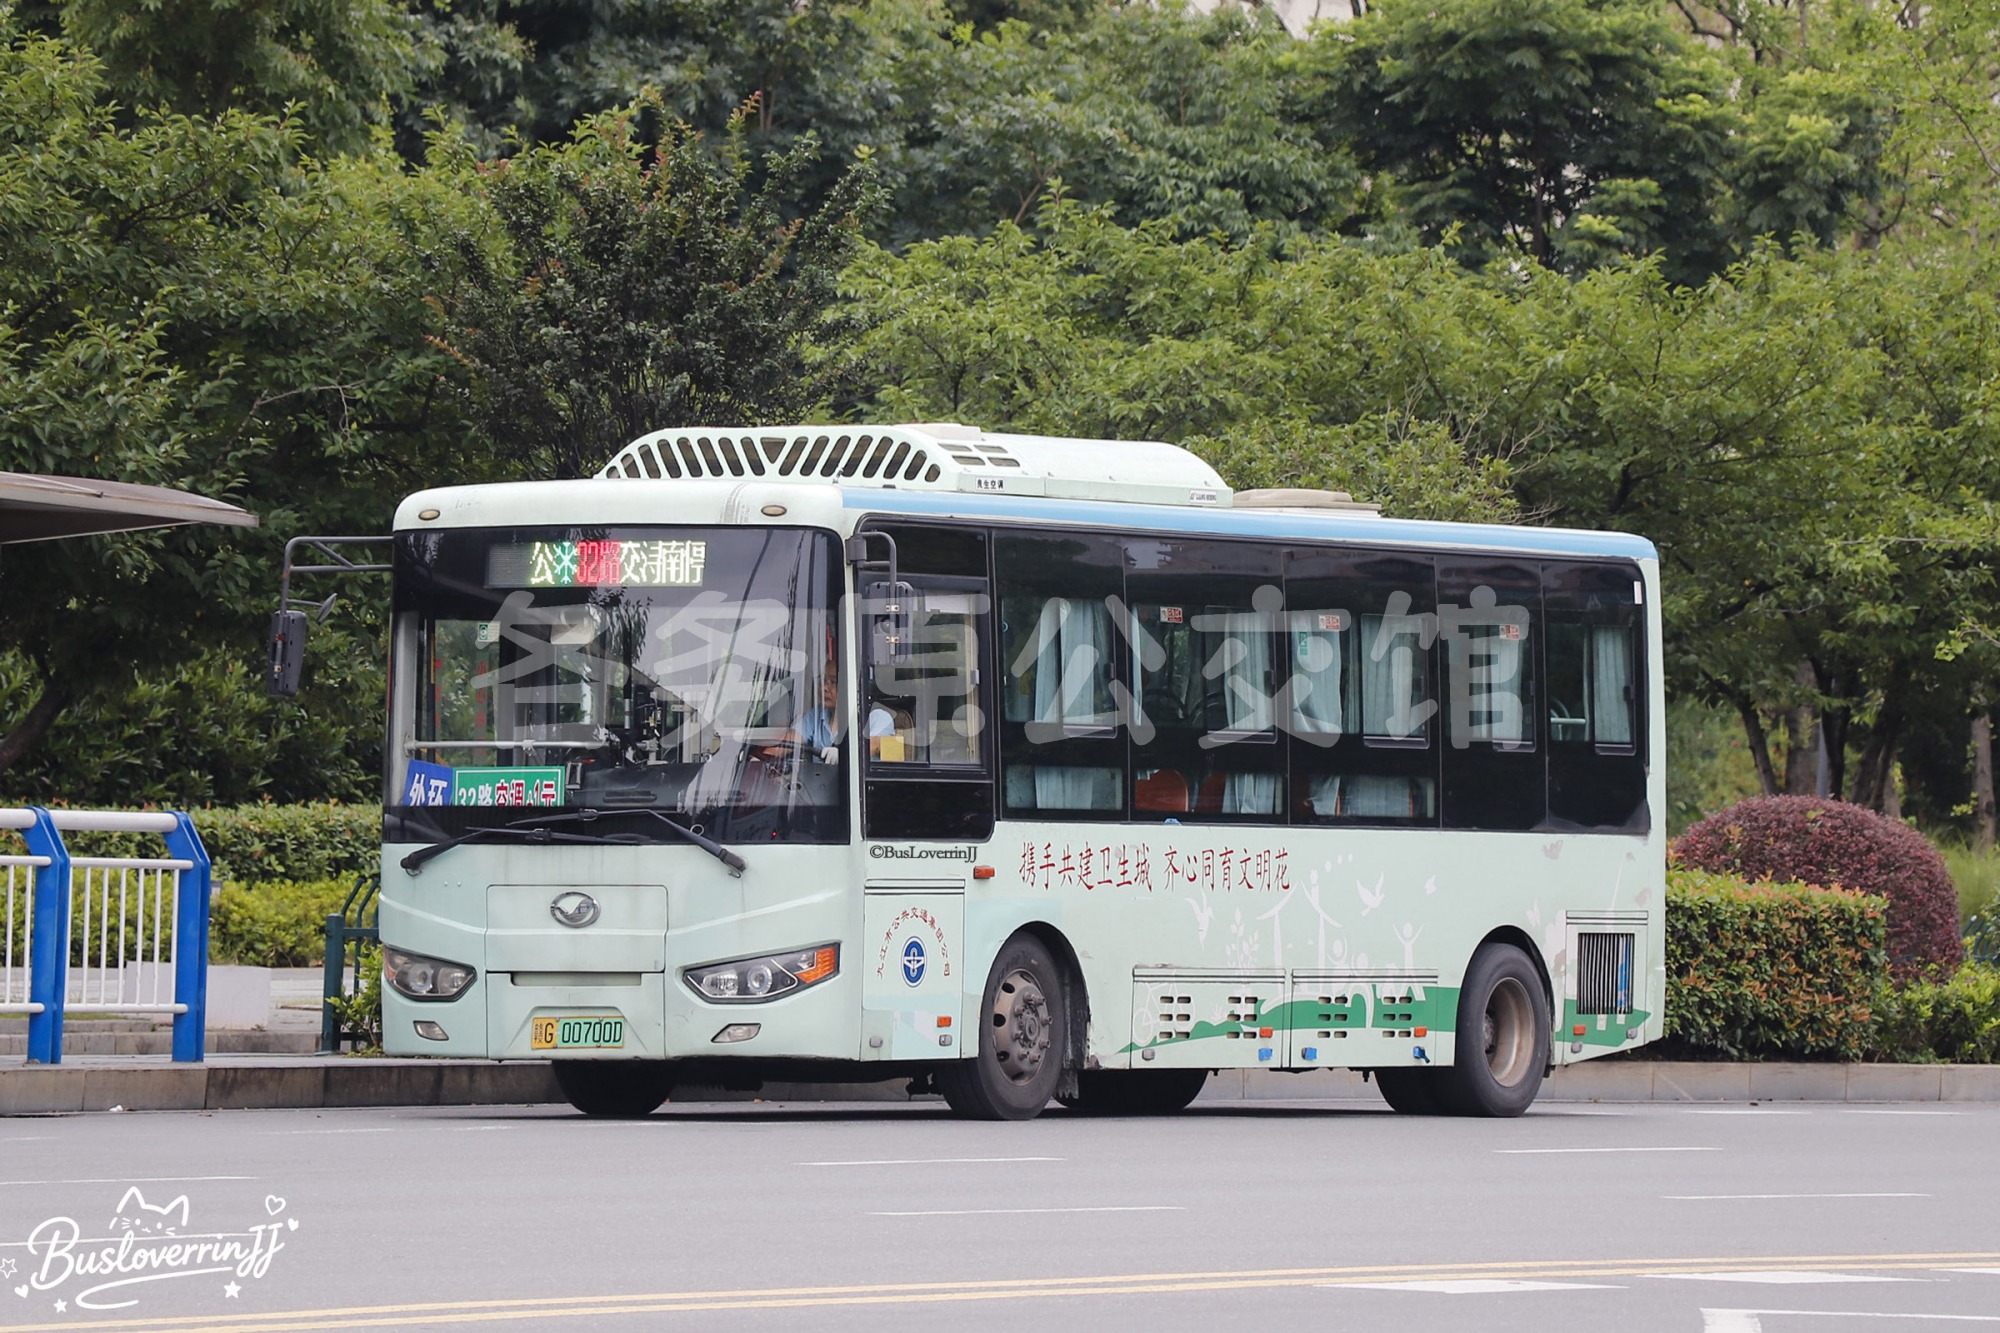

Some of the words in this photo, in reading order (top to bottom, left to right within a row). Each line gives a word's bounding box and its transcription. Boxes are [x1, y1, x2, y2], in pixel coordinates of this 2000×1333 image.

[408, 773, 448, 806] 外环
[1019, 841, 1153, 893] 携手共建卫生城
[1163, 845, 1290, 893] 齐心同育文明花
